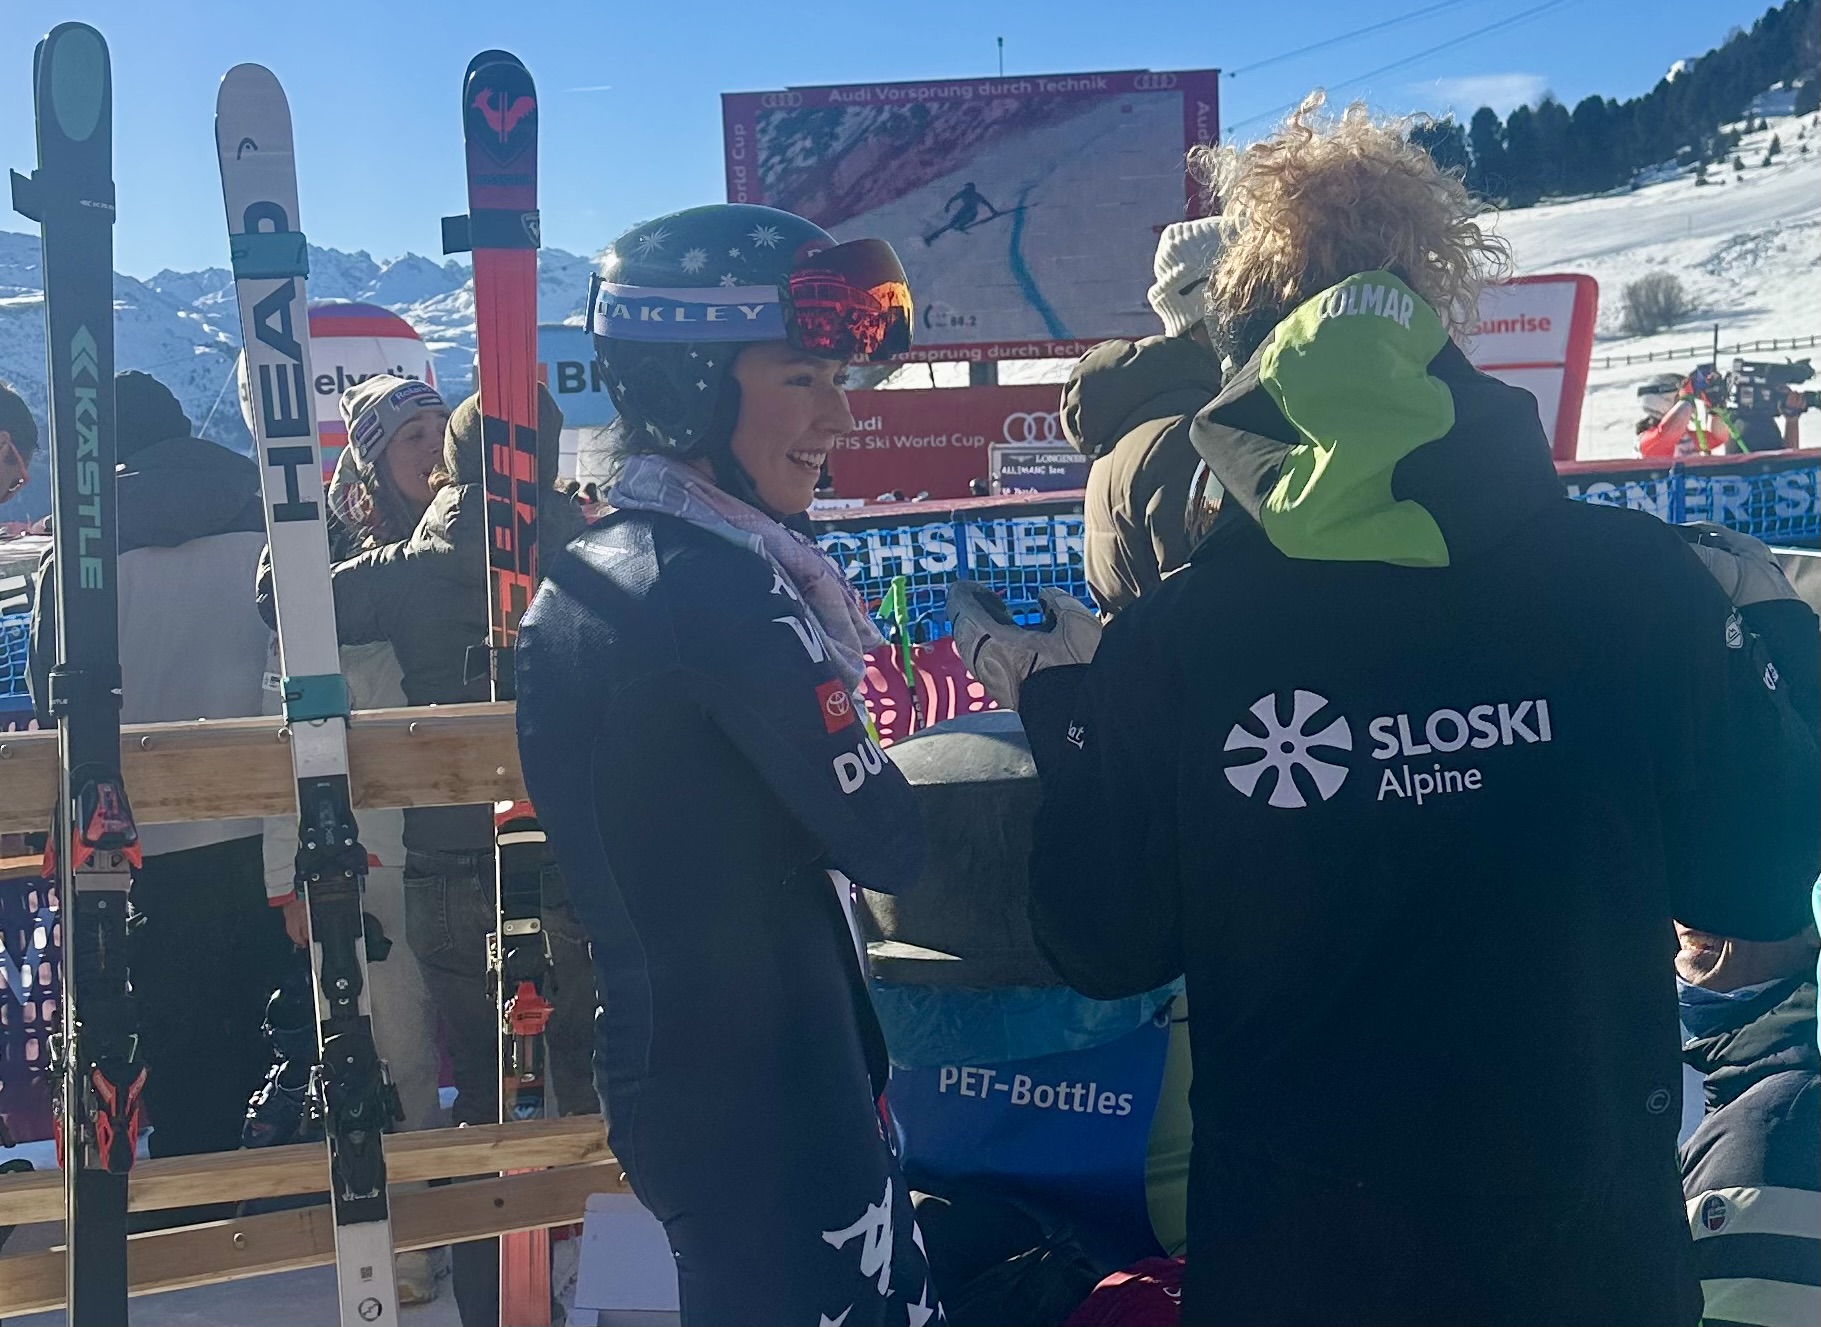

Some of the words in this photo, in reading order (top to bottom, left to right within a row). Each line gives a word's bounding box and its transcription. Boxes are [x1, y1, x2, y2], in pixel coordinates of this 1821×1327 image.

[828, 88, 871, 102] Audi
[876, 84, 973, 102] Vorsprung
[979, 80, 1031, 96] durch
[1036, 76, 1107, 93] Technik
[732, 123, 747, 159] Cup
[1197, 101, 1211, 143] Aud
[734, 165, 747, 203] orld
[1317, 283, 1414, 331] COLMAR
[890, 345, 981, 362] orsprung
[988, 343, 1040, 358] durch
[836, 436, 861, 450] FIS
[865, 434, 890, 449] Ski
[893, 433, 947, 448] World
[951, 433, 985, 448] Cup
[852, 416, 883, 431] udi
[1775, 468, 1821, 518] S
[817, 514, 1084, 580] CHSNER
[1368, 699, 1552, 760] SLOSKI
[1376, 763, 1483, 806] Alpine
[939, 1065, 1134, 1117] PET-Bottles
